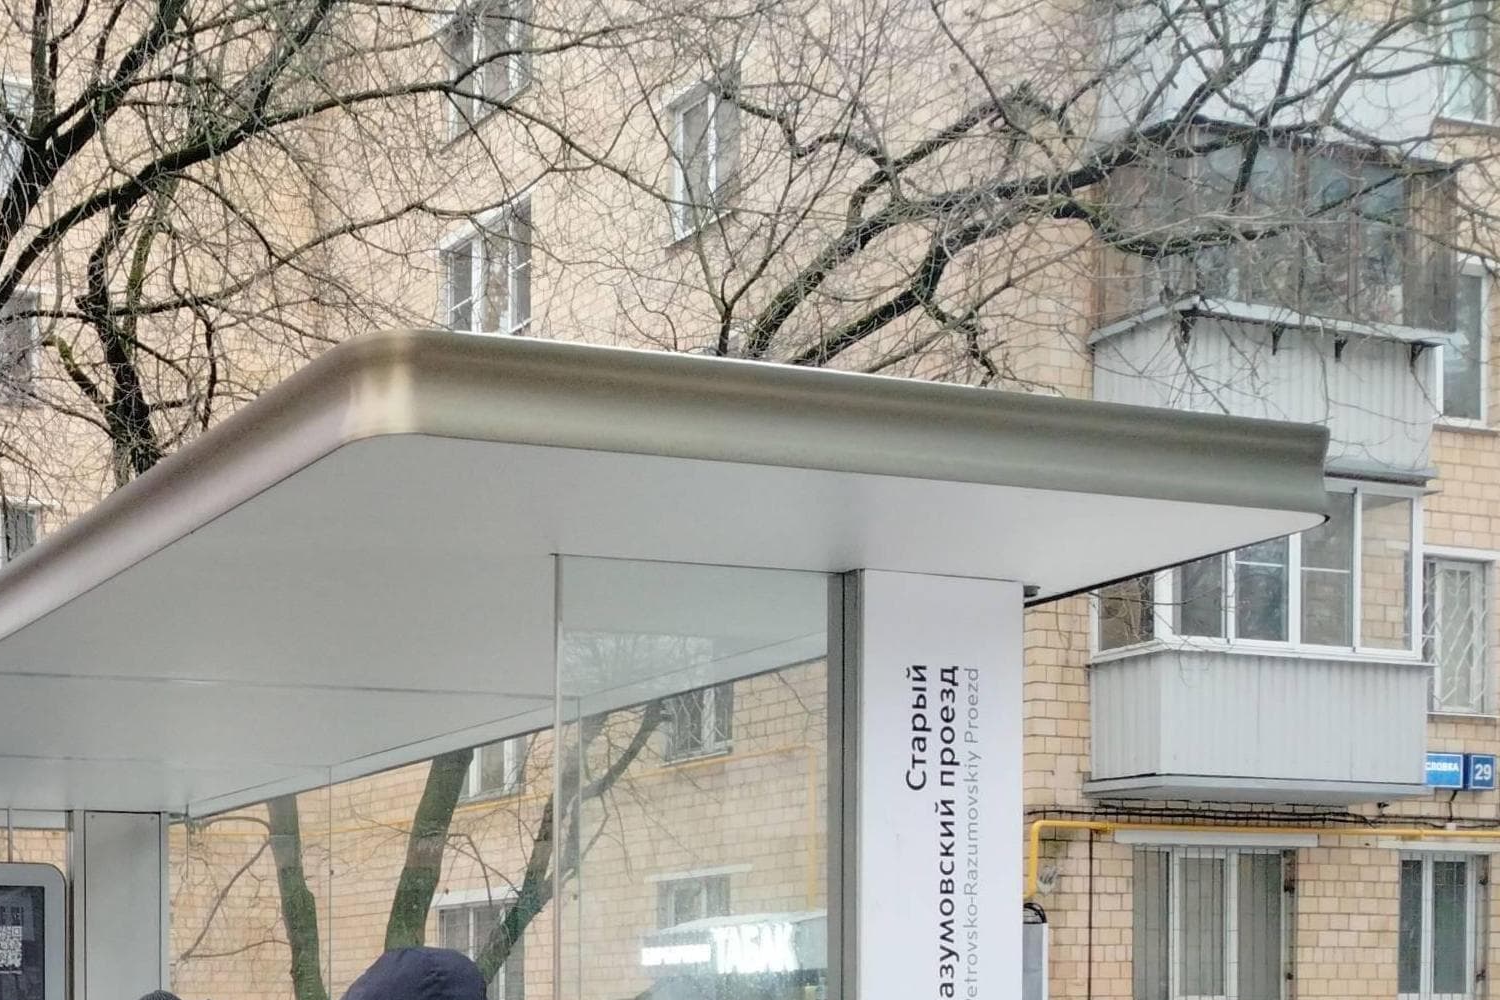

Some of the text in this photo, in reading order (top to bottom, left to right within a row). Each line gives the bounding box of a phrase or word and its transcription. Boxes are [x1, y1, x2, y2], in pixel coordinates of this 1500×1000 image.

[905, 664, 932, 791] Старый
[939, 665, 960, 787] проезд
[963, 668, 980, 744] Proezd
[1474, 763, 1493, 781] 29
